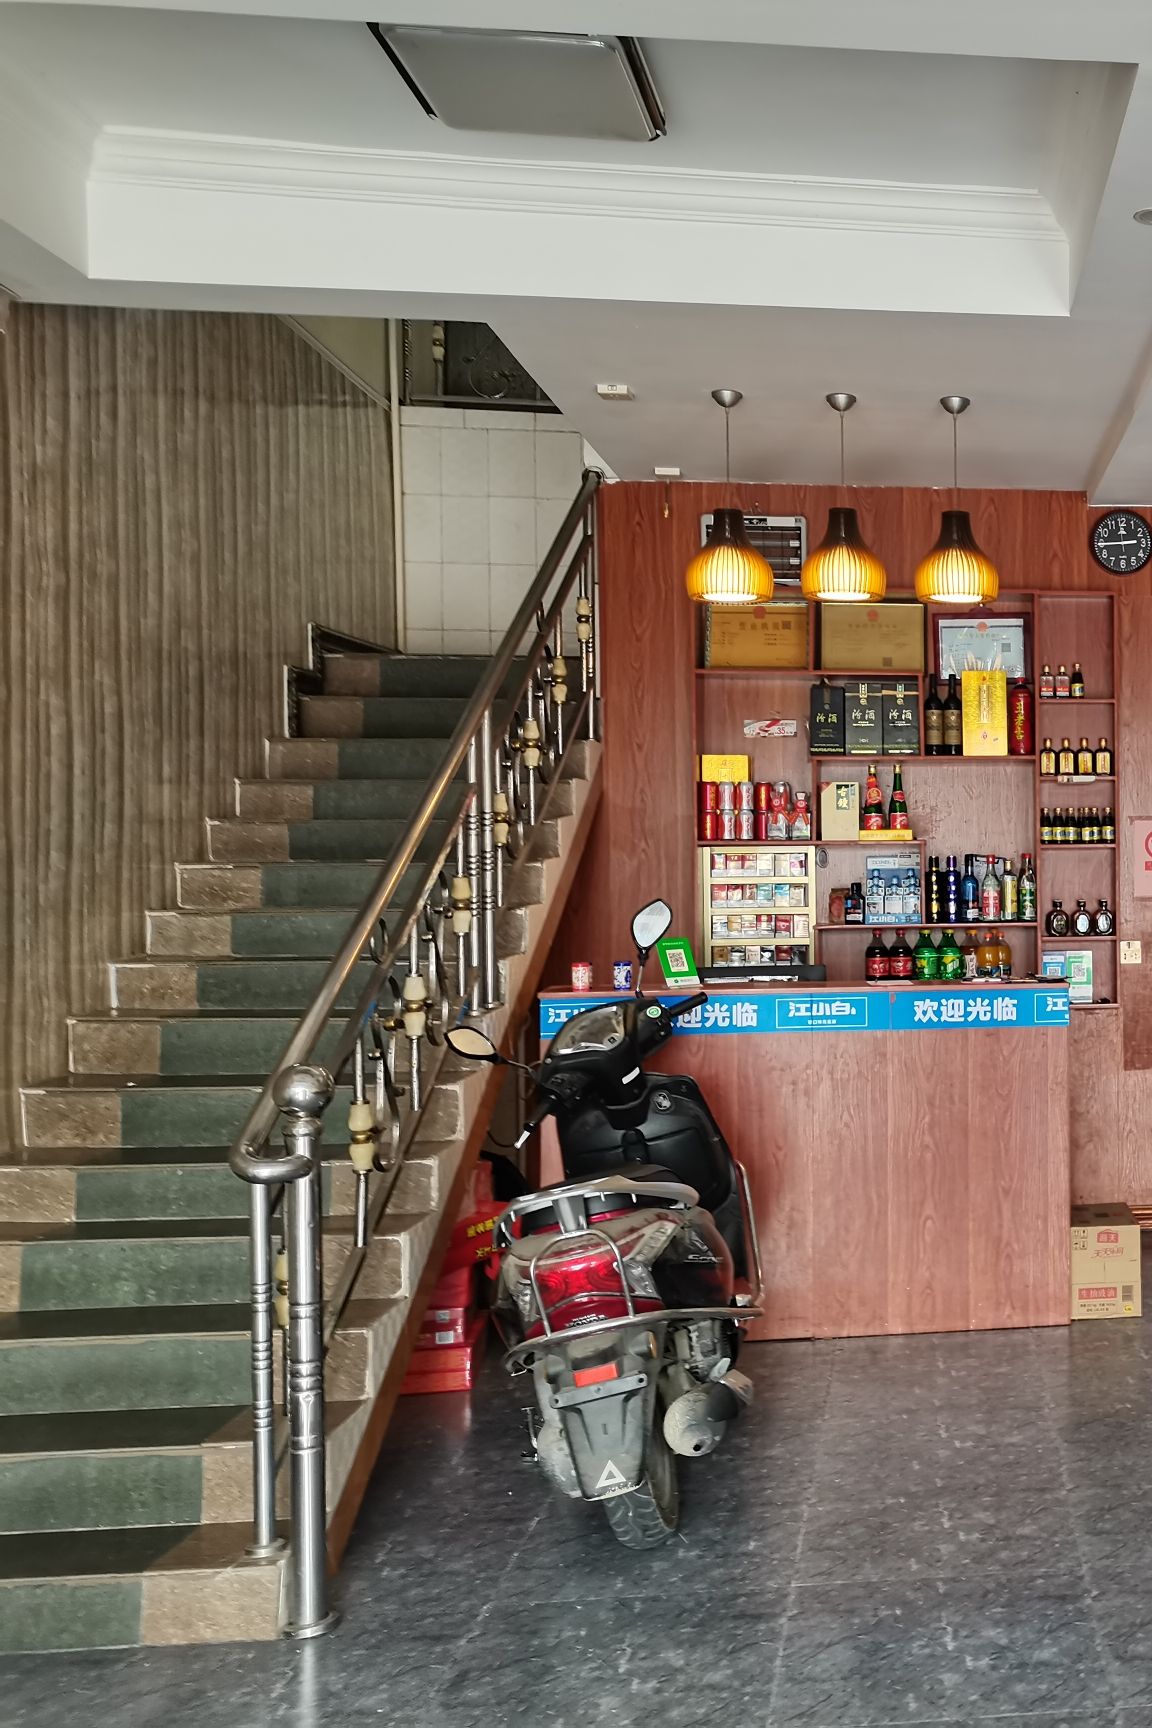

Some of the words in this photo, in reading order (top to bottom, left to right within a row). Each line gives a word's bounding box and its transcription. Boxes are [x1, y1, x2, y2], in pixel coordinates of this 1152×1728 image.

[816, 713, 837, 723] 汾酒
[852, 709, 875, 720] 汾酒
[889, 709, 912, 720] 汾酒
[672, 1002, 758, 1028] 迎光临
[788, 1001, 852, 1017] 江小白
[914, 997, 1017, 1023] 欢迎光临
